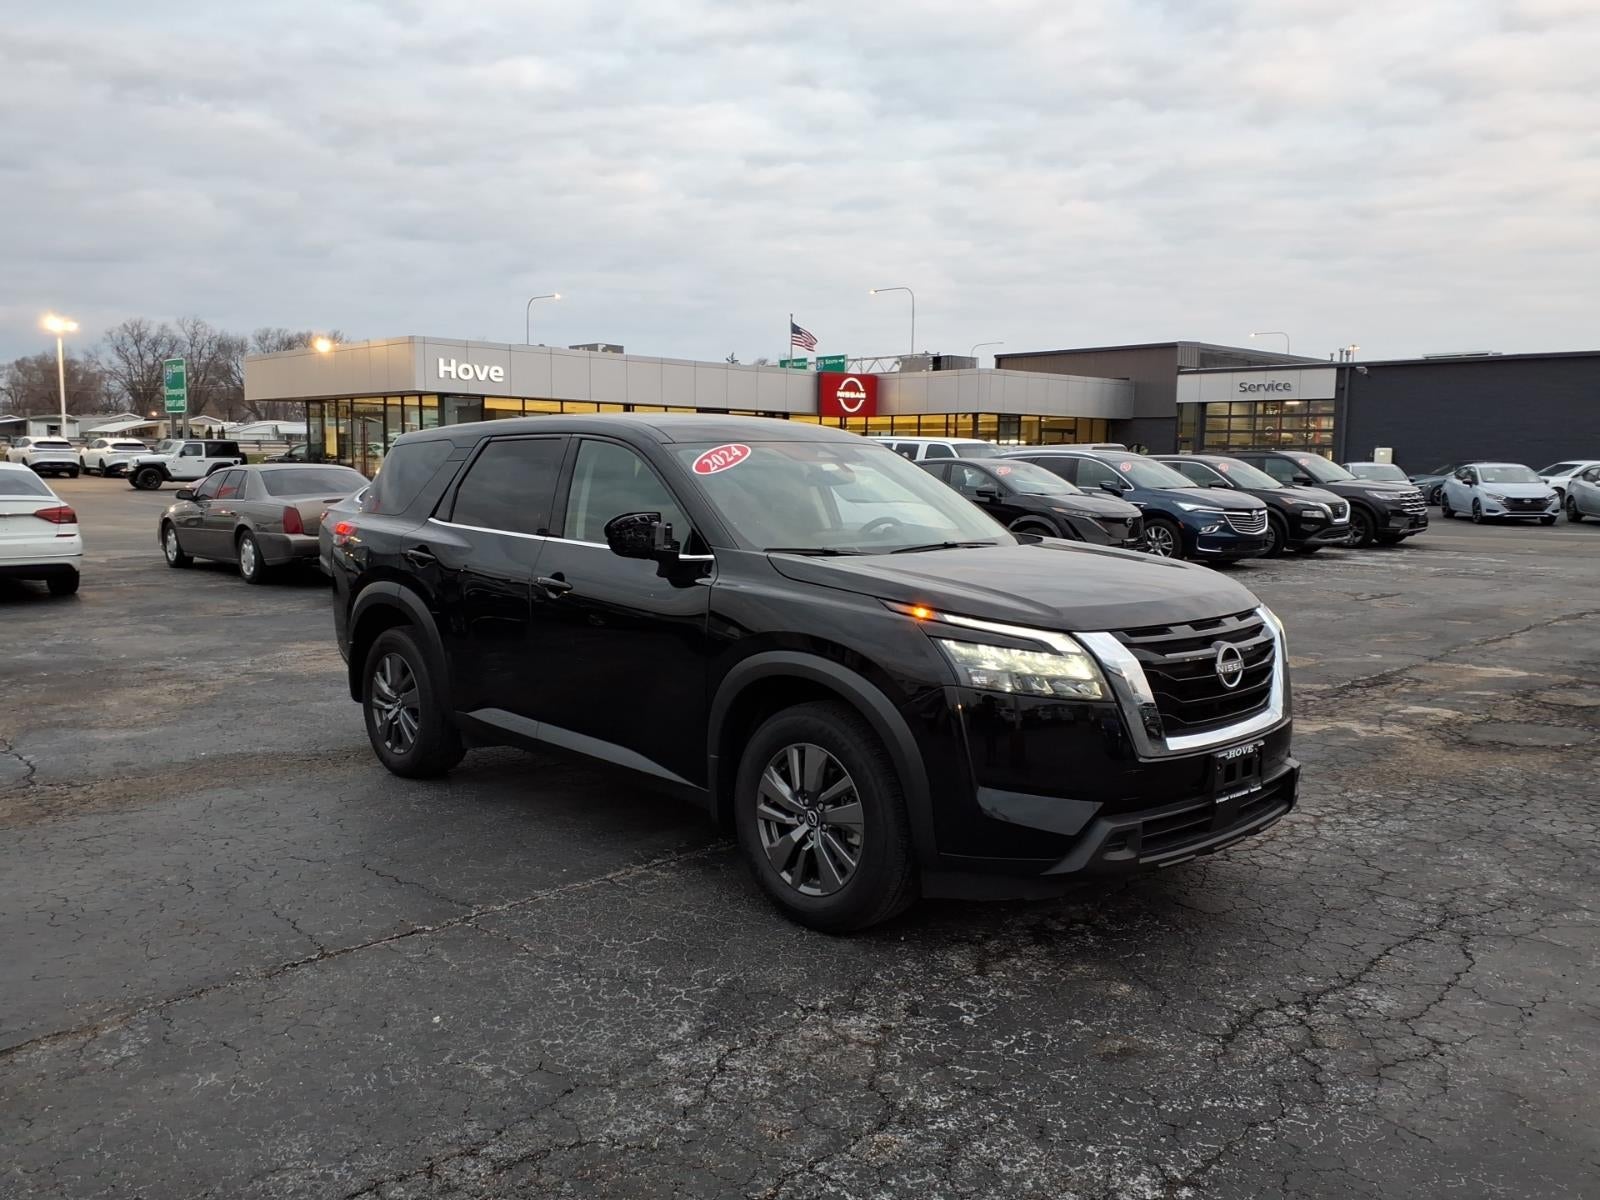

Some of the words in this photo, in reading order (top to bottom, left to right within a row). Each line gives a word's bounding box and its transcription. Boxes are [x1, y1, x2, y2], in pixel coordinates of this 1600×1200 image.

[438, 358, 504, 382] Hove
[837, 390, 866, 398] NISSAN
[1239, 380, 1292, 393] Service
[702, 446, 742, 471] 2024
[1227, 744, 1254, 759] HOVE
